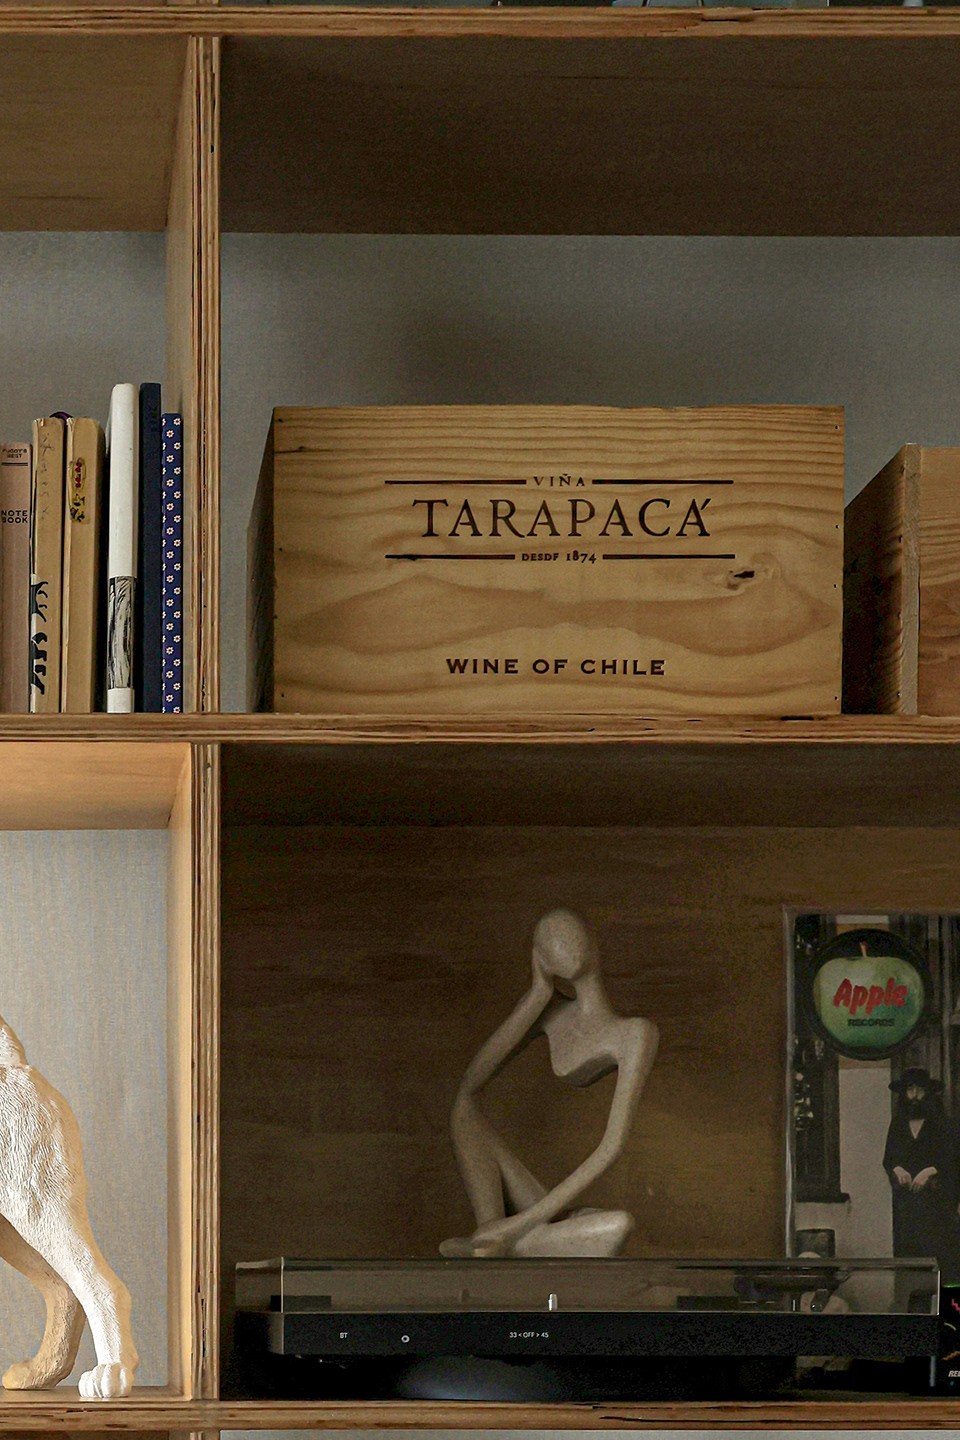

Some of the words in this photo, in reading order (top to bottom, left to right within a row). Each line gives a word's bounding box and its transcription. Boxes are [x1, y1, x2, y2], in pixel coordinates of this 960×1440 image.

[533, 474, 586, 488] VIÑA
[2, 516, 28, 524] BOOK
[413, 498, 711, 538] TARAPACÁ
[566, 549, 597, 565] 1874
[446, 659, 519, 675] WINE
[532, 659, 569, 675] OF
[581, 659, 665, 676] CHILE
[833, 977, 908, 1016] Apple
